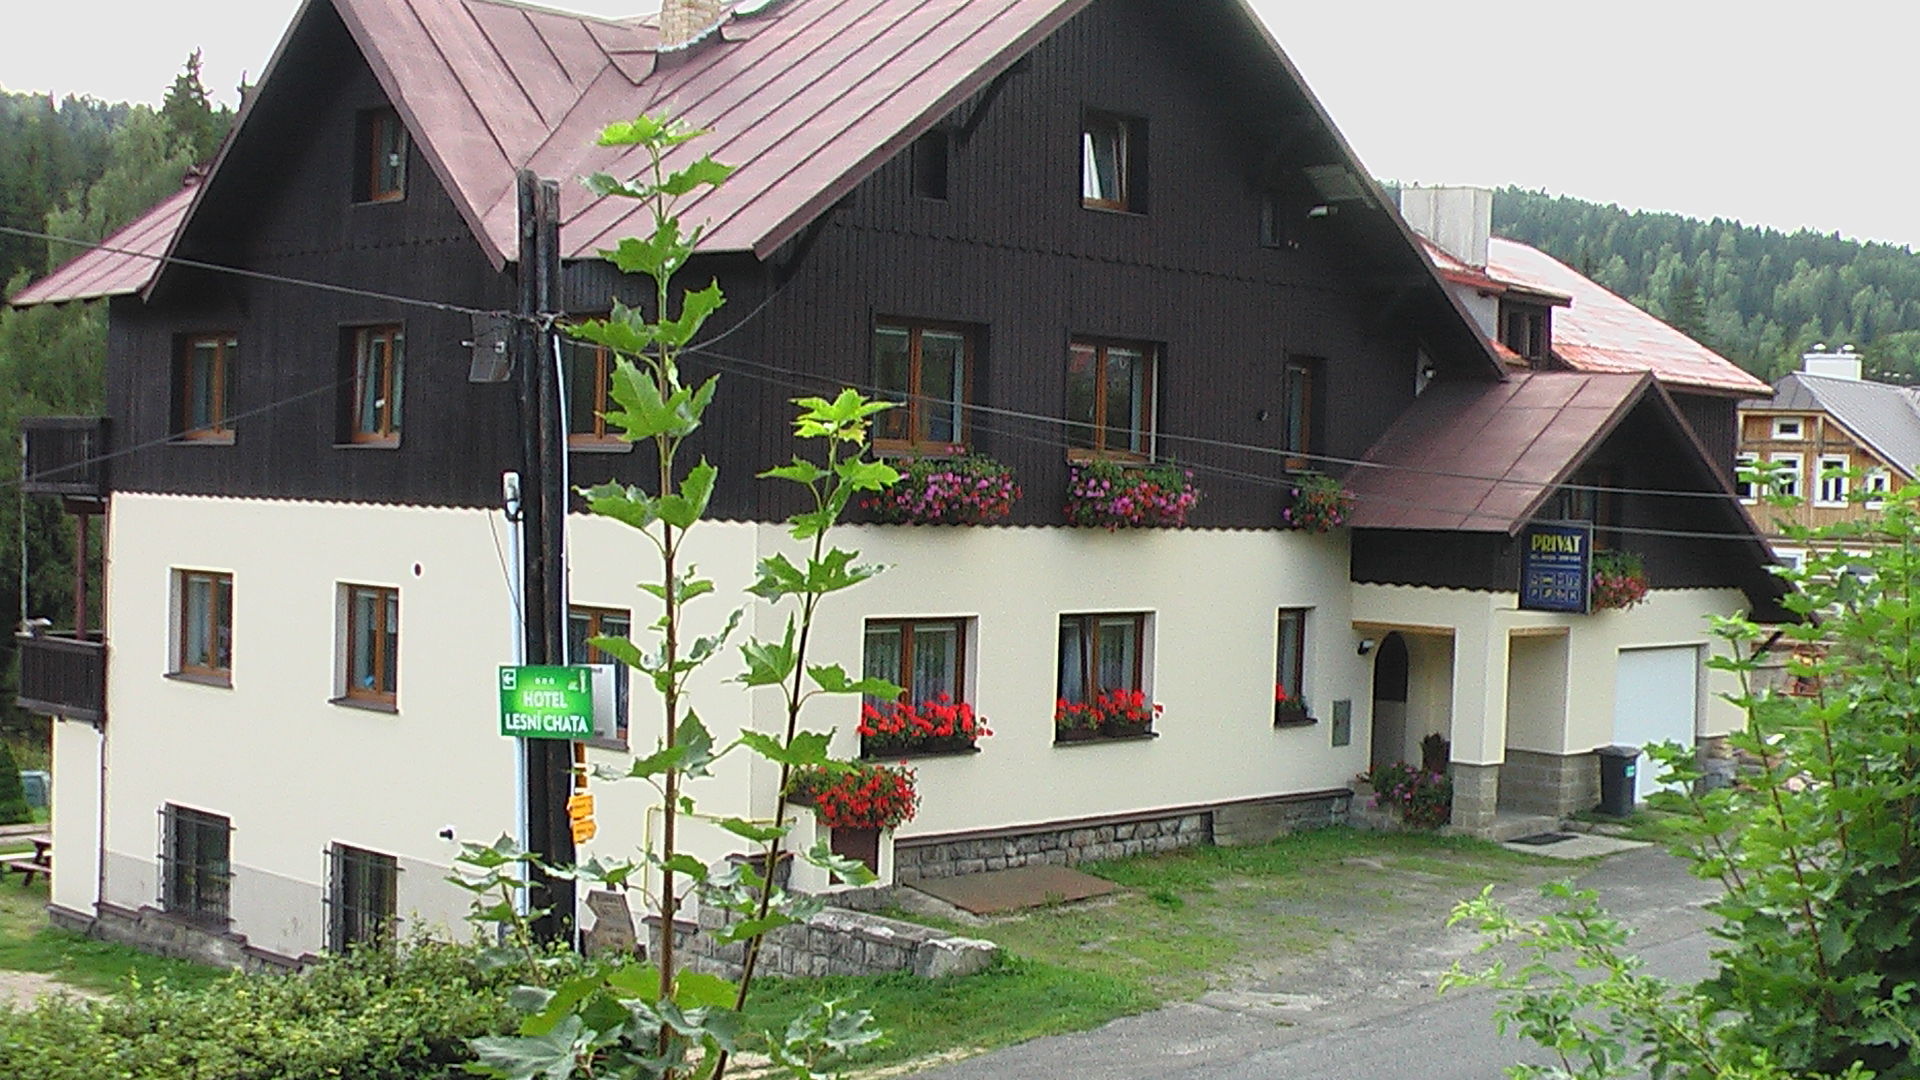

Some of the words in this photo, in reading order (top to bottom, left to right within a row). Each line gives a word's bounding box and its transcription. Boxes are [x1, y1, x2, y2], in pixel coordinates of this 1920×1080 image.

[1531, 533, 1582, 553] PRIVAT
[522, 690, 568, 708] HOTEL
[505, 711, 542, 732] LESNÍ
[543, 714, 588, 733] CHATA
